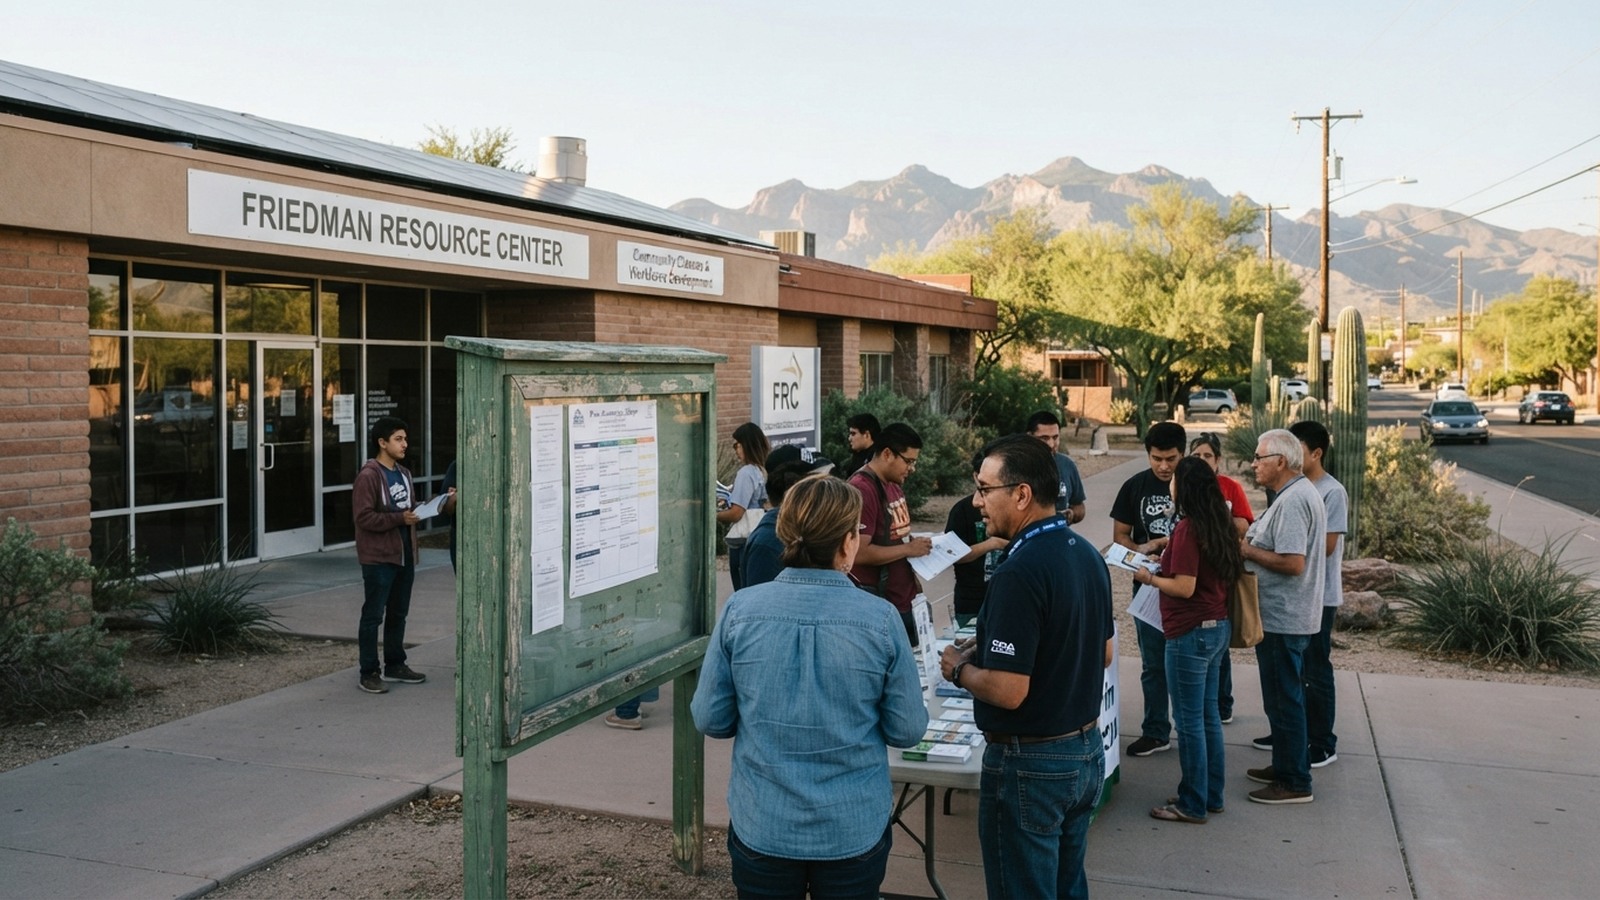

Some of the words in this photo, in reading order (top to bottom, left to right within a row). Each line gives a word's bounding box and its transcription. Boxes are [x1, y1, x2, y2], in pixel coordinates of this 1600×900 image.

[242, 191, 372, 242] FRIEDMAN
[380, 213, 491, 257] RESOURCE
[496, 231, 563, 267] CENTER
[772, 381, 799, 410] FRC
